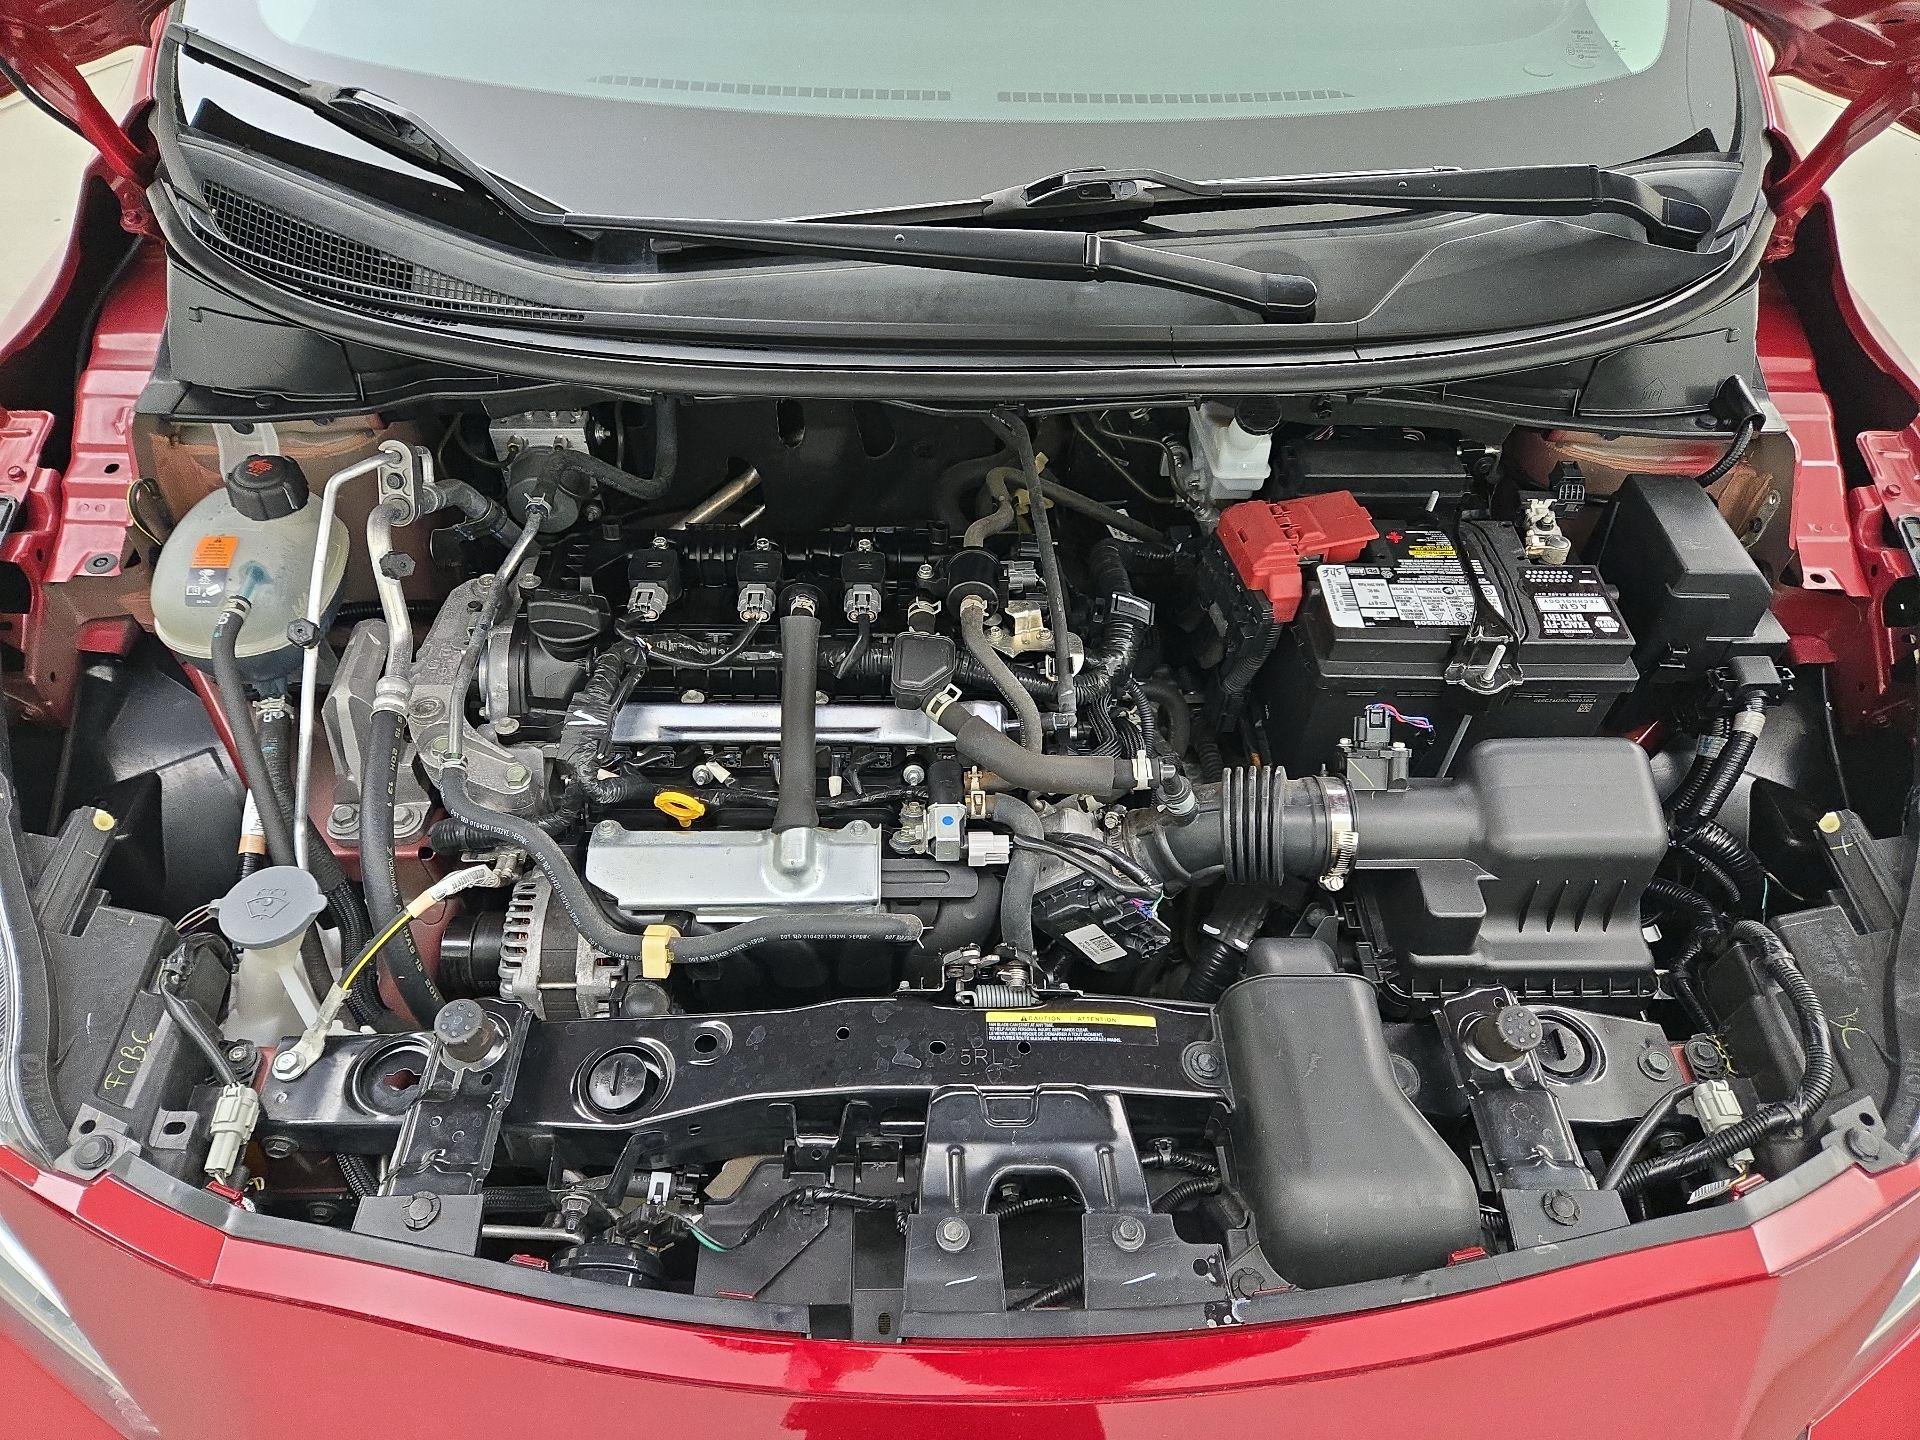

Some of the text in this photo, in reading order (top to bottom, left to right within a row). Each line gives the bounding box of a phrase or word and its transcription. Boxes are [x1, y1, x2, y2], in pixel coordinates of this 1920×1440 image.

[1543, 613, 1585, 621] BATTERY
[1543, 620, 1591, 629] EXACT-FIT
[387, 857, 399, 898] YOKOHAMA
